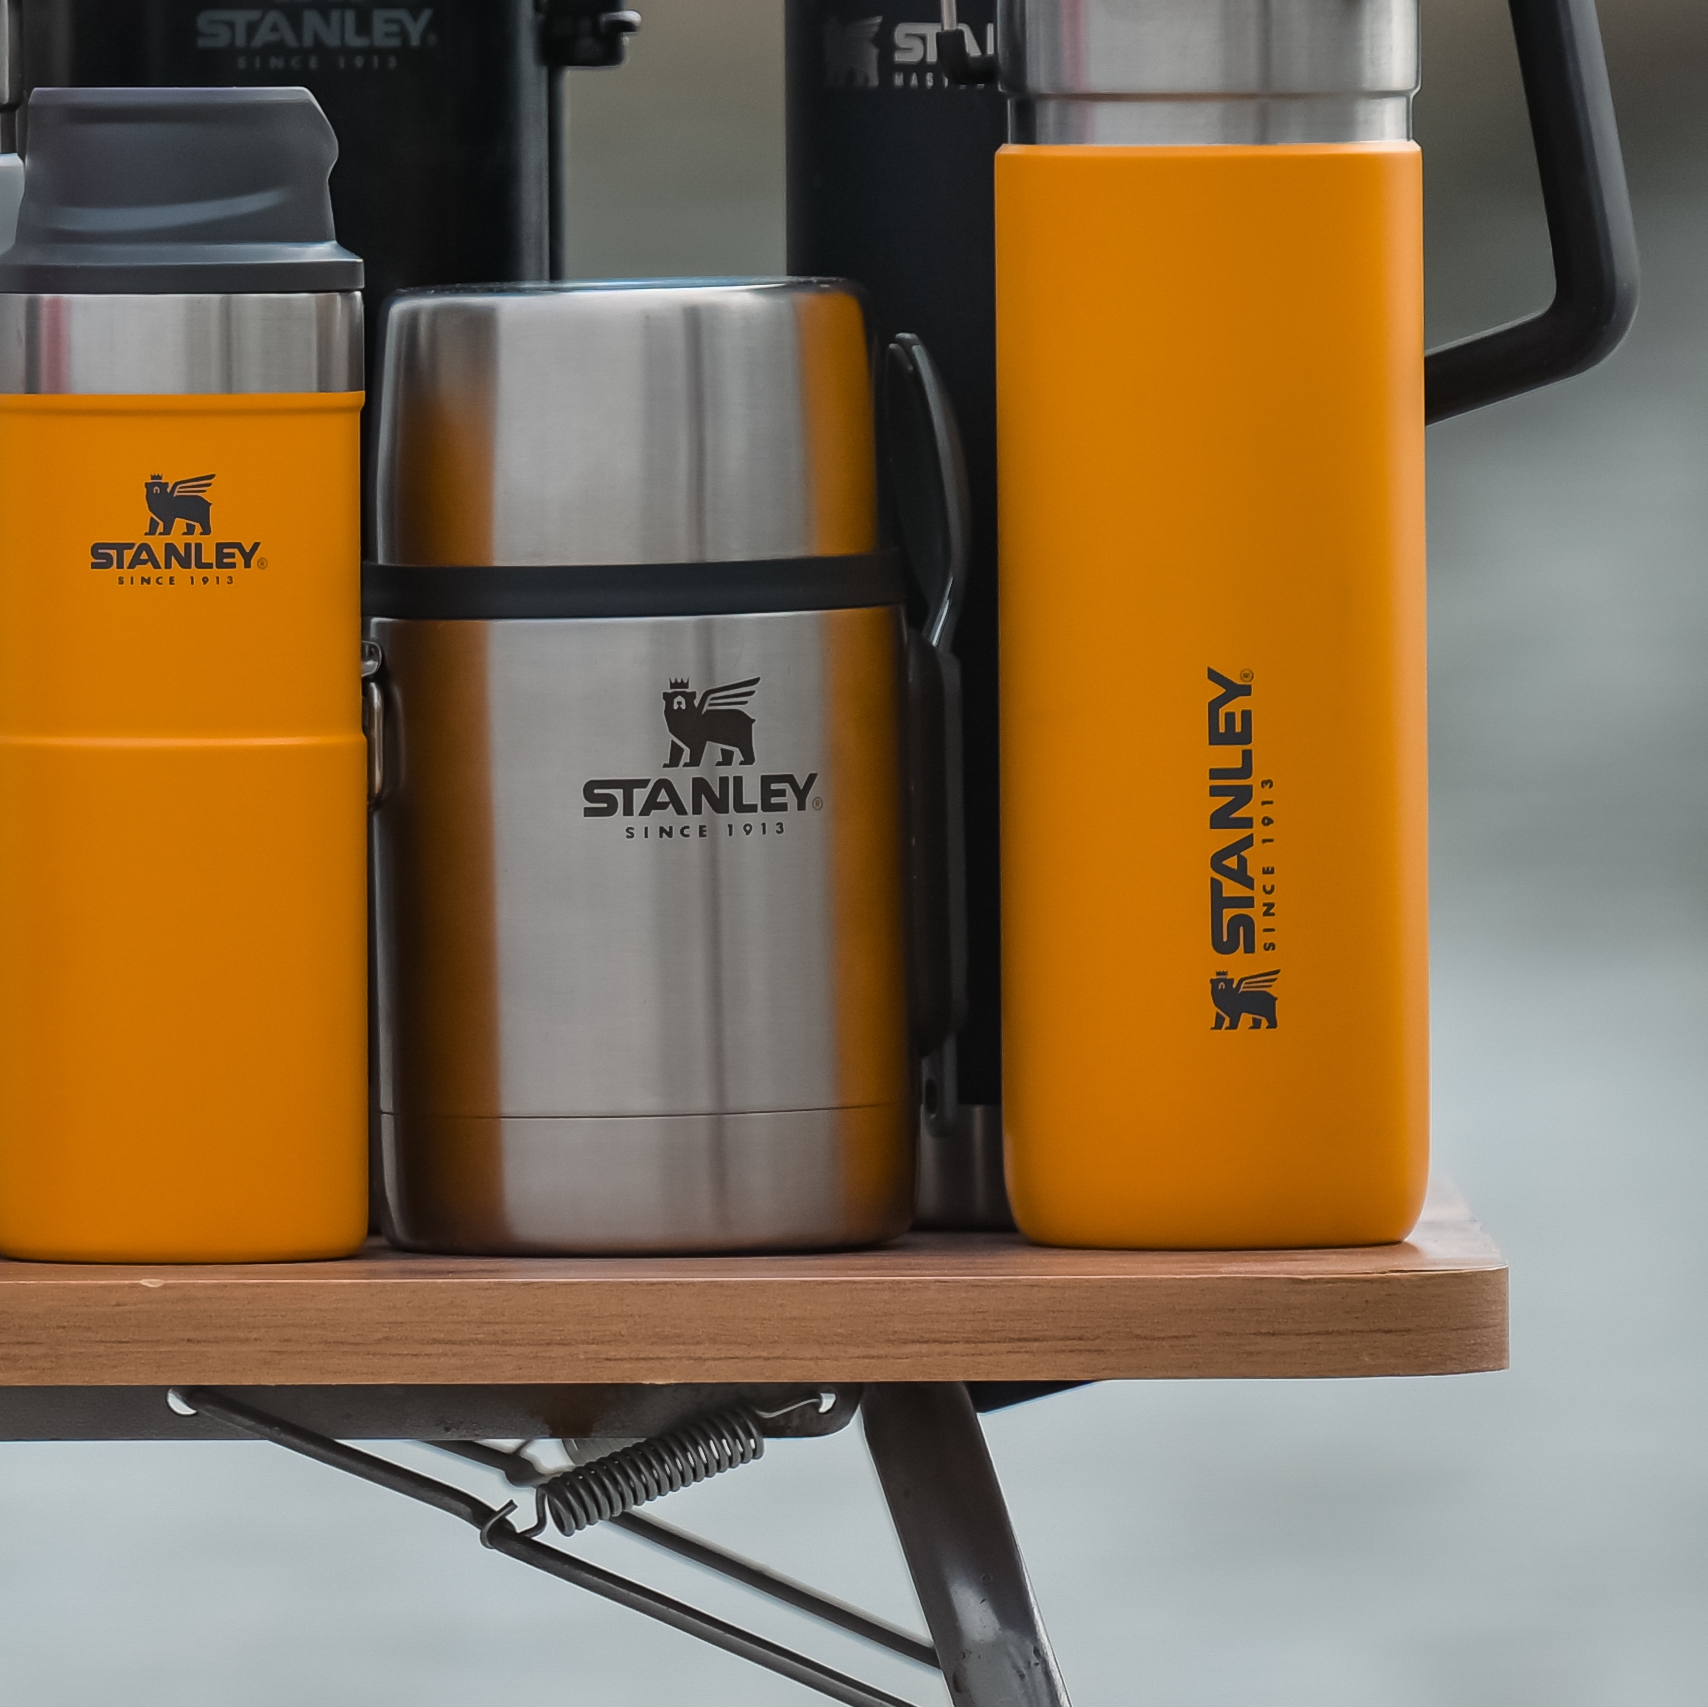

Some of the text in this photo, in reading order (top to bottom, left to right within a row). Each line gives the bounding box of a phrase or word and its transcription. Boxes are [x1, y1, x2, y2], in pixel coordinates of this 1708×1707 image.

[195, 7, 433, 48] STANLEY
[236, 55, 398, 70] SINCE 1913
[90, 541, 262, 570] STANLEY
[118, 576, 235, 586] SINCE 1913
[583, 772, 819, 818] STANLEY
[1207, 666, 1256, 955] STANLEY
[625, 822, 785, 839] SINCE 1913
[1261, 778, 1276, 952] SINCE 1913
